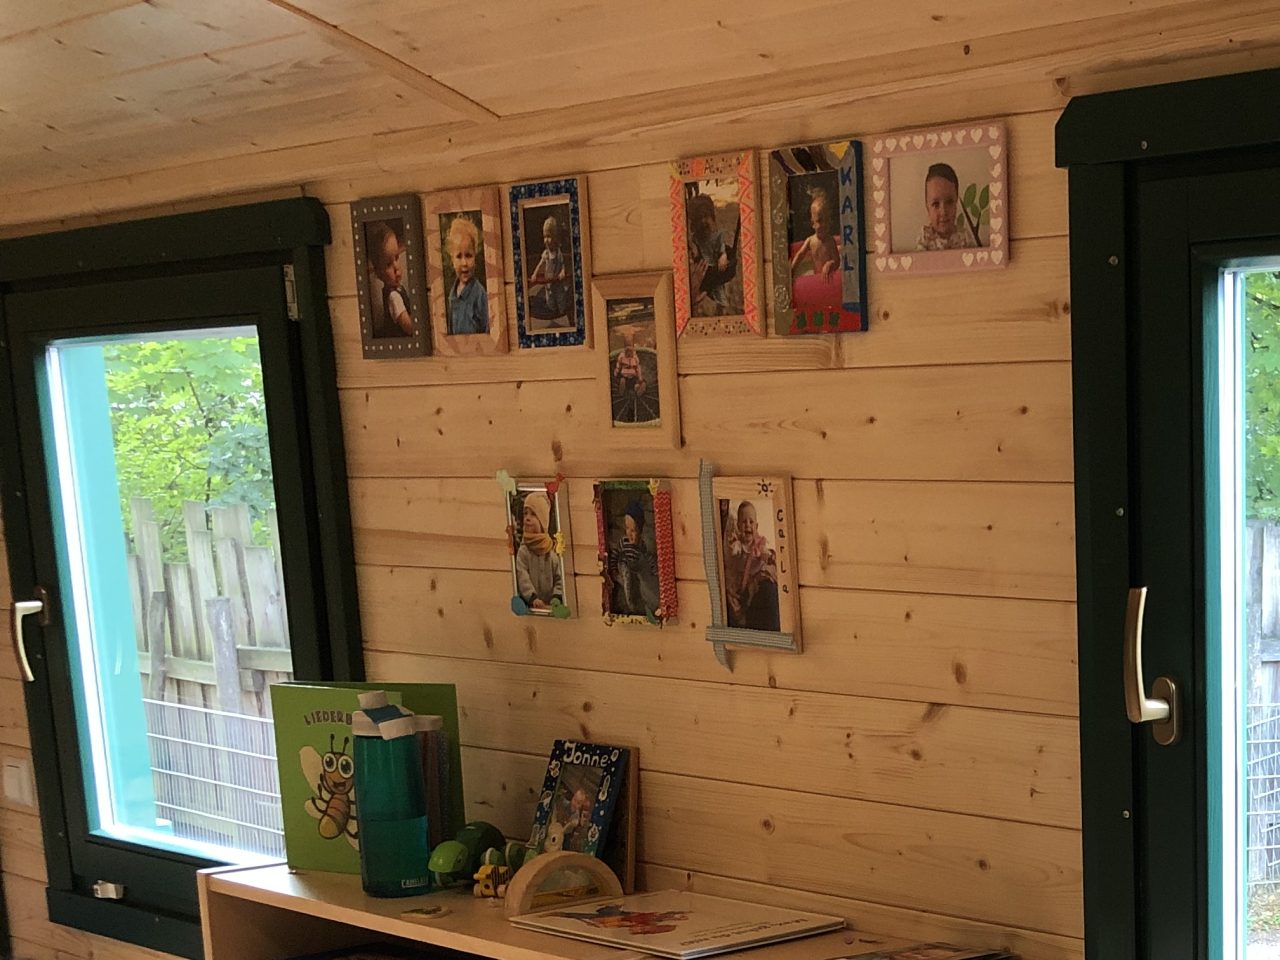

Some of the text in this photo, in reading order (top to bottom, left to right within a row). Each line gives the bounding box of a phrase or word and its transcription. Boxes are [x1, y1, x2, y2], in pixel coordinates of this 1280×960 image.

[840, 166, 854, 272] KARL
[304, 710, 352, 726] LIEDERB
[563, 742, 608, 767] Jonne
